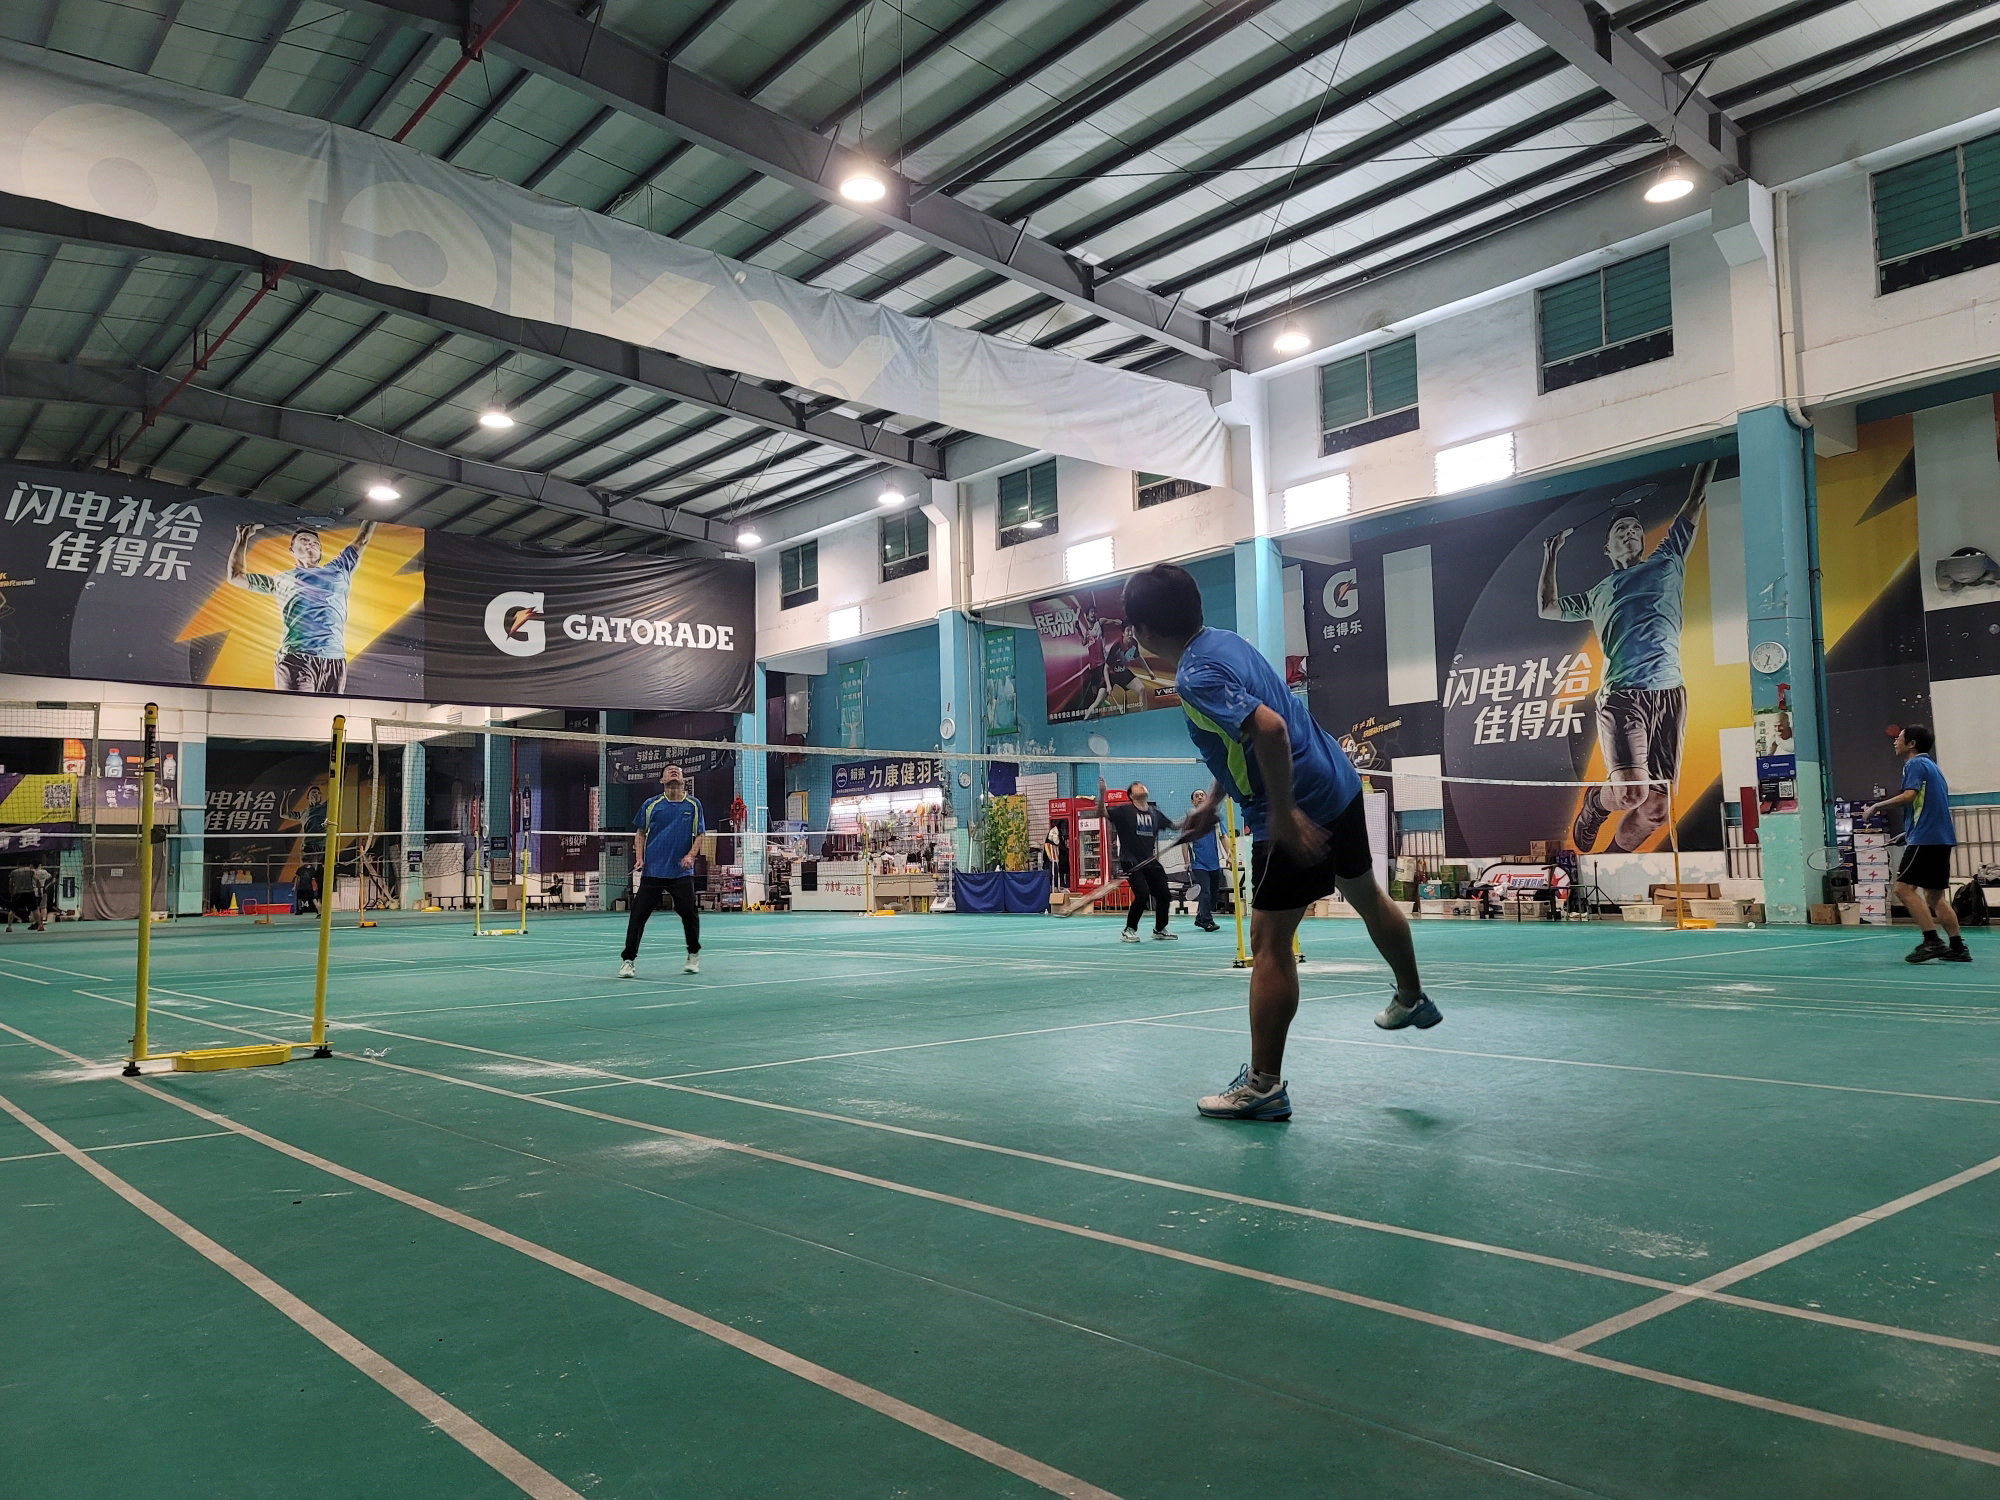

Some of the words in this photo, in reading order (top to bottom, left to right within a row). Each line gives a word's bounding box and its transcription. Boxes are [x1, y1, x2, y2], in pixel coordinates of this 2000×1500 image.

[4, 481, 204, 543] 闪电补给
[46, 530, 194, 581] 佳得乐
[1322, 568, 1360, 619] G
[484, 591, 545, 656] G
[562, 614, 735, 652] GATORADE
[1034, 609, 1080, 628] READY
[1039, 627, 1049, 635] TO
[1048, 622, 1075, 638] WIN
[1322, 619, 1363, 640] 佳得乐
[1443, 652, 1593, 711] 闪电补给
[1472, 697, 1585, 746] 佳得乐
[205, 811, 272, 831] 佳得乐
